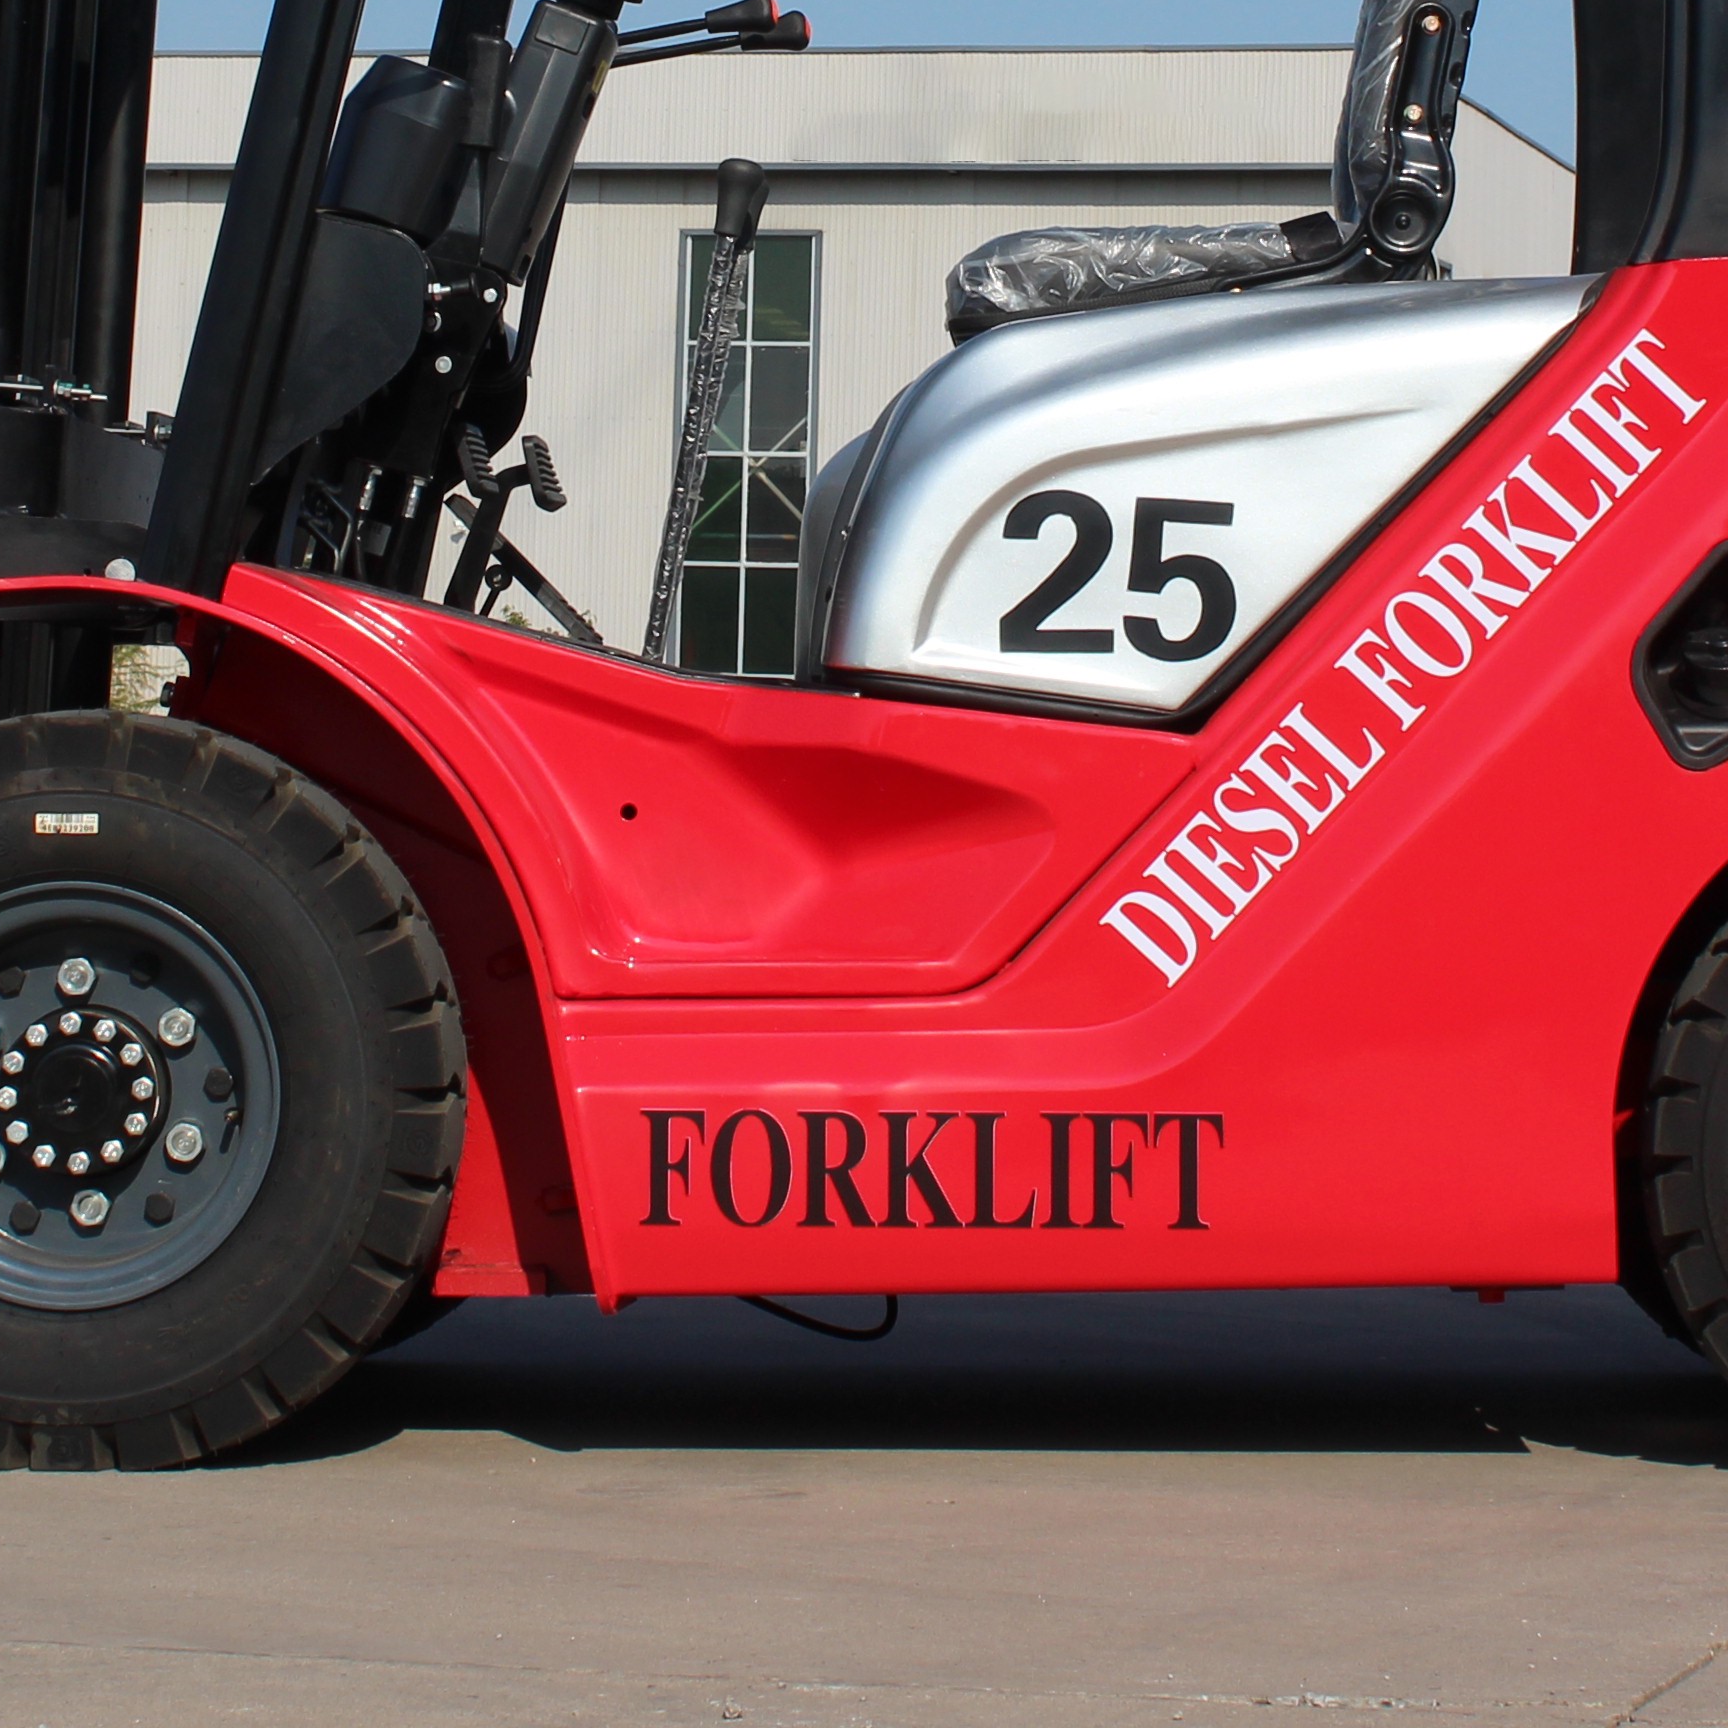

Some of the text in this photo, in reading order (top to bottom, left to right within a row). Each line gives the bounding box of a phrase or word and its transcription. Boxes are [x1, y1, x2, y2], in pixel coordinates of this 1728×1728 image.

[1000, 491, 1236, 661] 25
[1100, 329, 1706, 988] DIESEL FORKLIFT
[641, 1111, 1223, 1229] FORKLIFT
